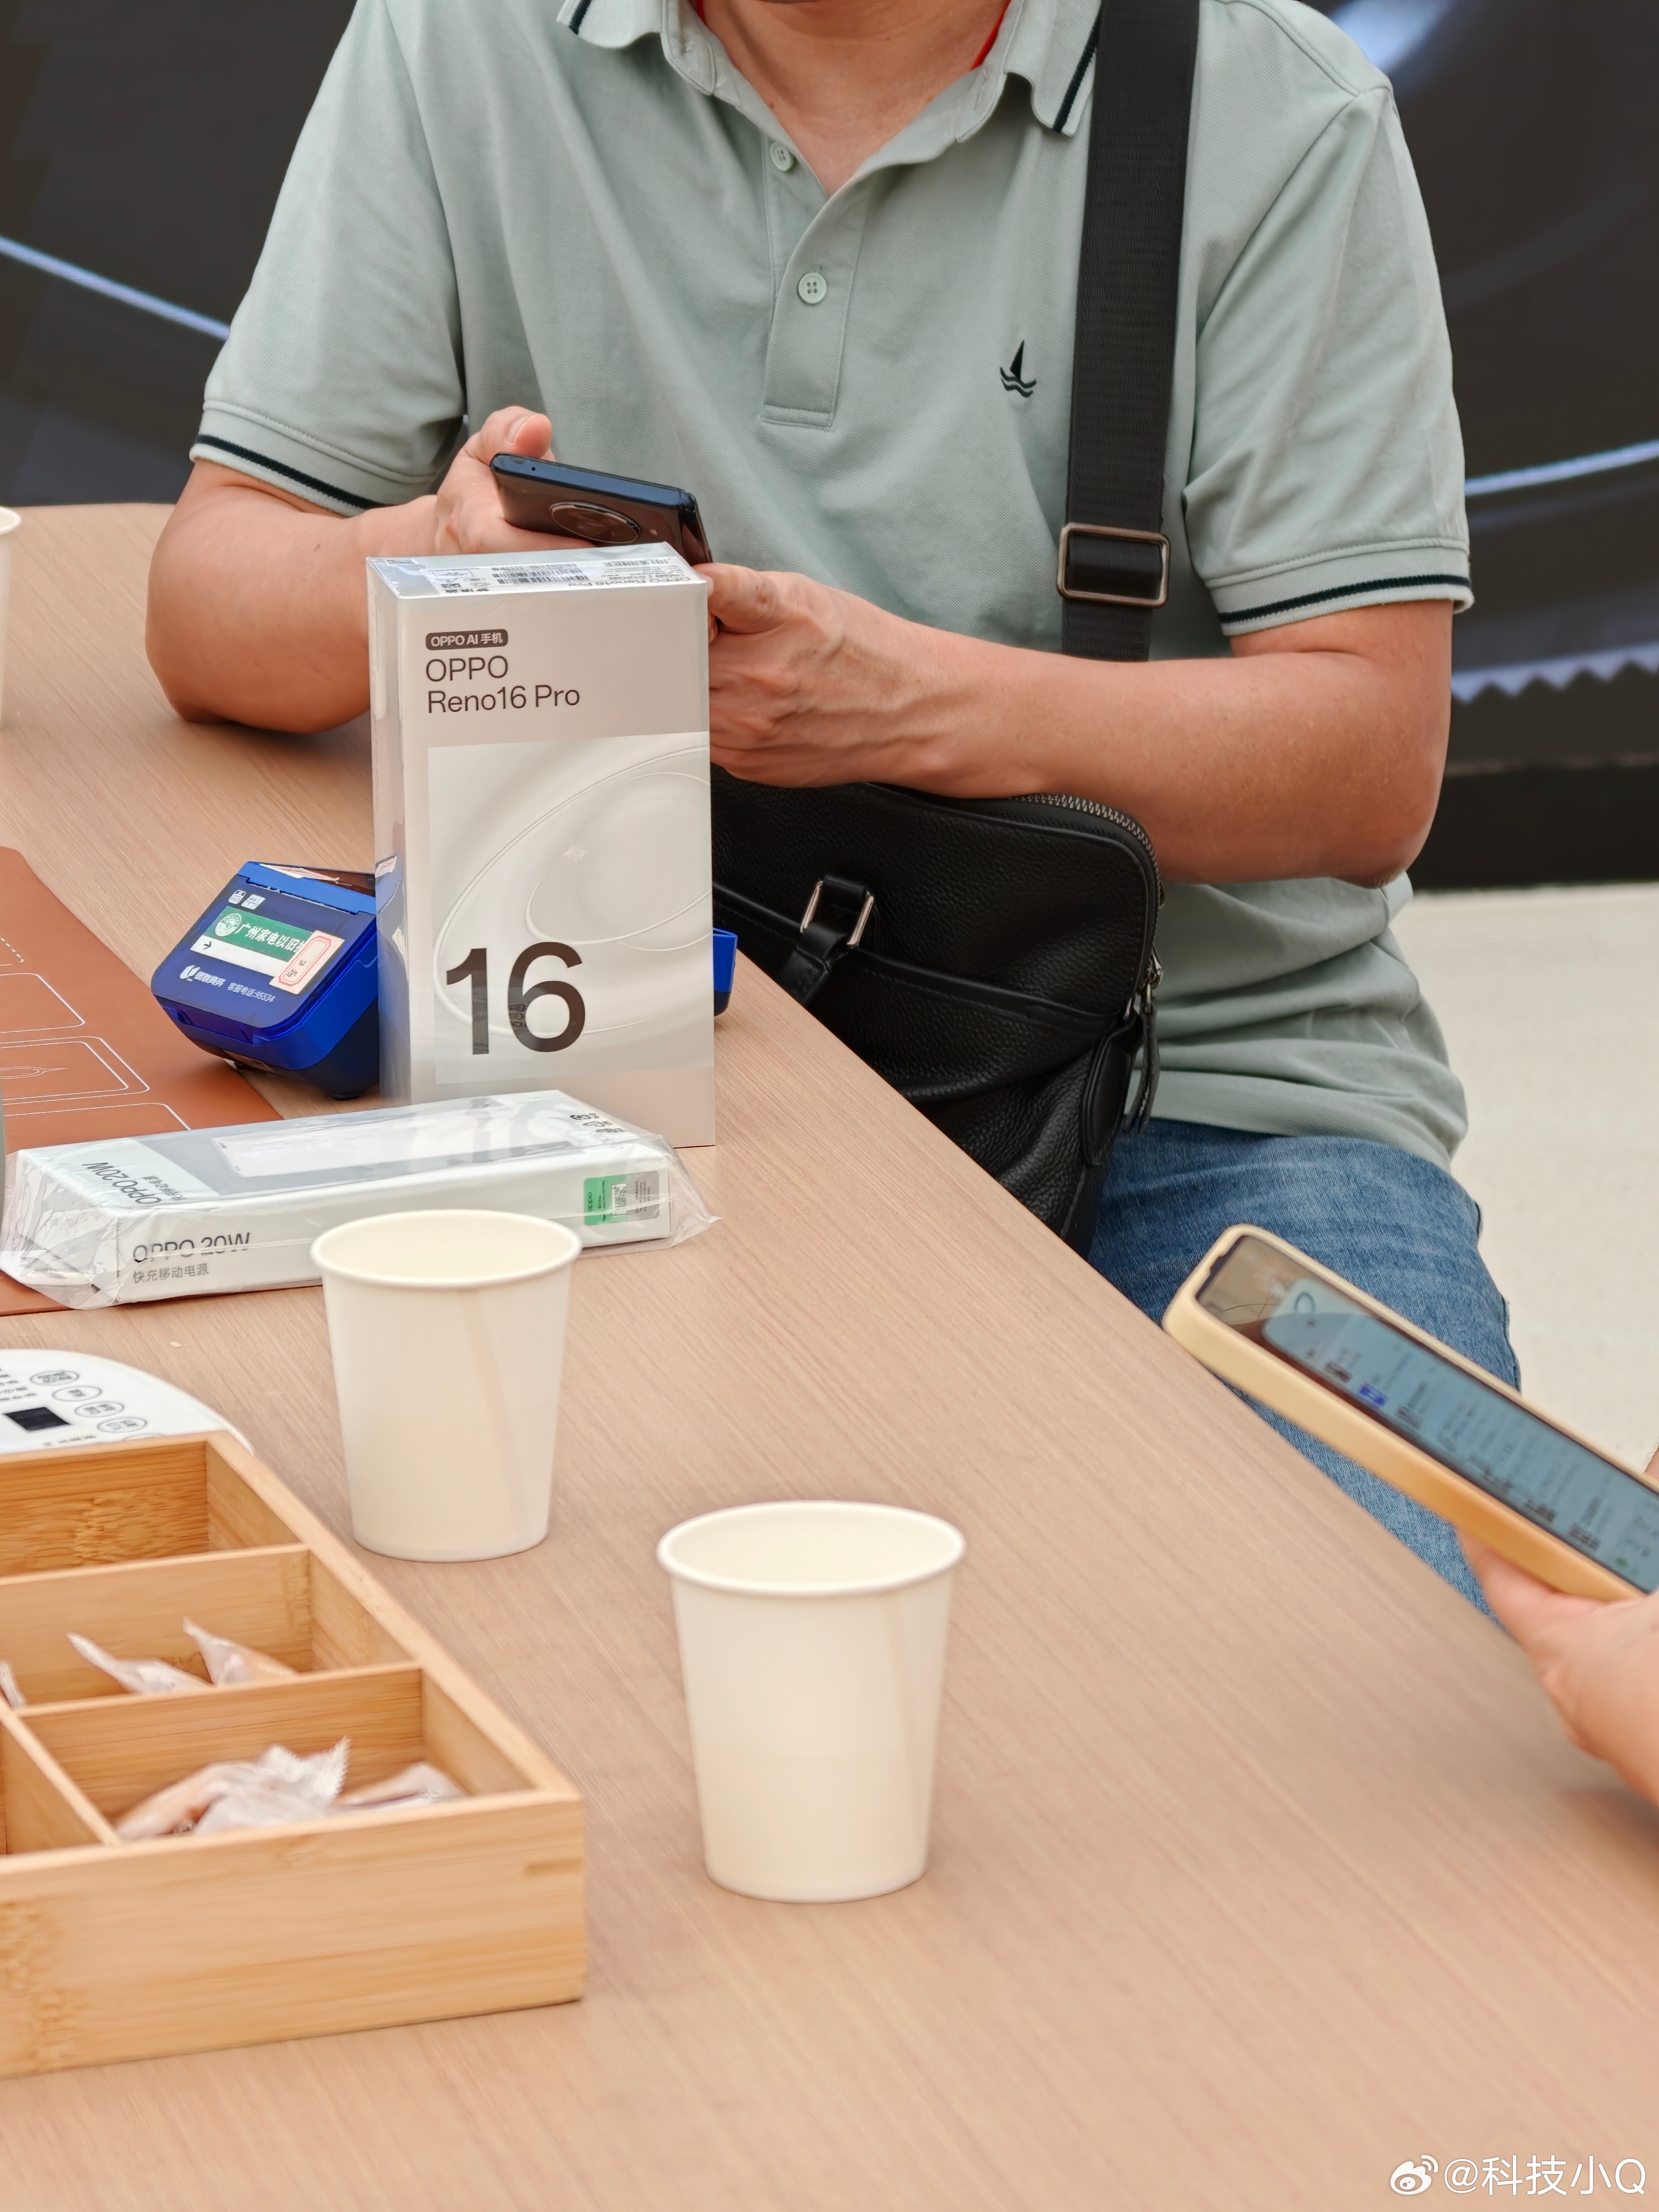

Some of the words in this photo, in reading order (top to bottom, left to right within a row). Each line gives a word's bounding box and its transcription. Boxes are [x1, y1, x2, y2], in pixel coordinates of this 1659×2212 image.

[431, 635, 465, 647] OPPO
[466, 634, 478, 645] AI
[480, 632, 503, 644] 手机
[426, 655, 508, 682] OPPO
[428, 685, 527, 713] Reno16
[535, 684, 580, 708] Pro
[446, 941, 586, 1056] 16
[82, 1162, 129, 1180] 20W
[112, 1180, 162, 1204] OPPO
[133, 1239, 195, 1263] OPPO
[201, 1232, 250, 1255] 20W
[133, 1263, 209, 1283] 快充移动电源
